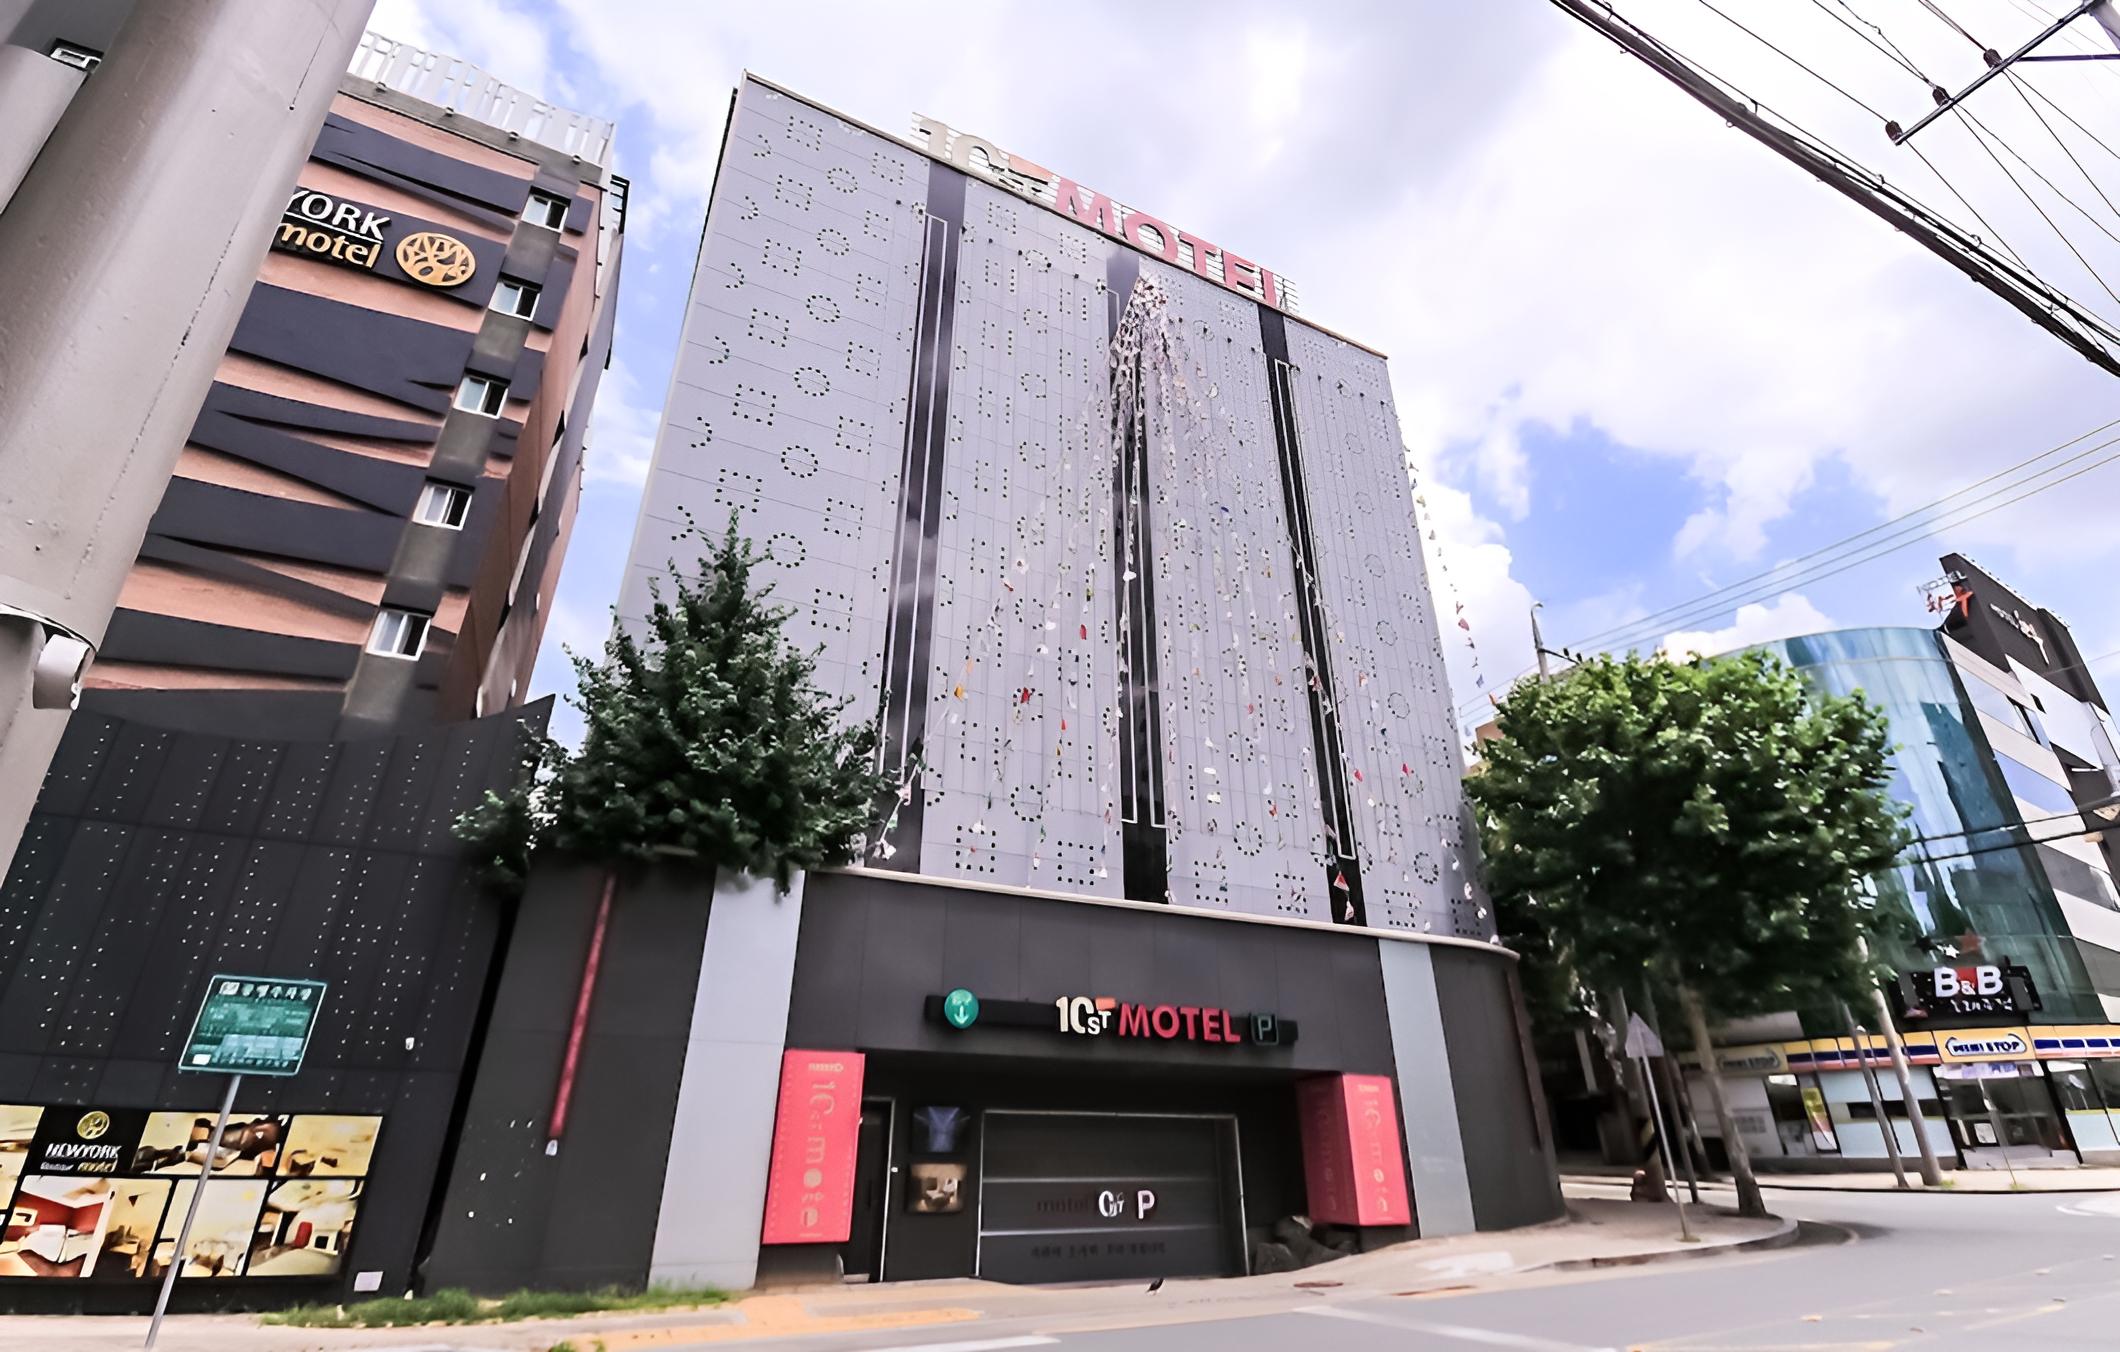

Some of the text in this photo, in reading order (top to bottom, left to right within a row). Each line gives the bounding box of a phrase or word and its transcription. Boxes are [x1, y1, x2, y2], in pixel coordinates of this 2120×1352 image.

[1055, 178, 1281, 308] MOTEL
[1934, 965, 2003, 998] B&B
[1119, 1002, 1241, 1042] MOTEL
[1257, 1015, 1273, 1041] P
[1137, 1189, 1155, 1219] P
